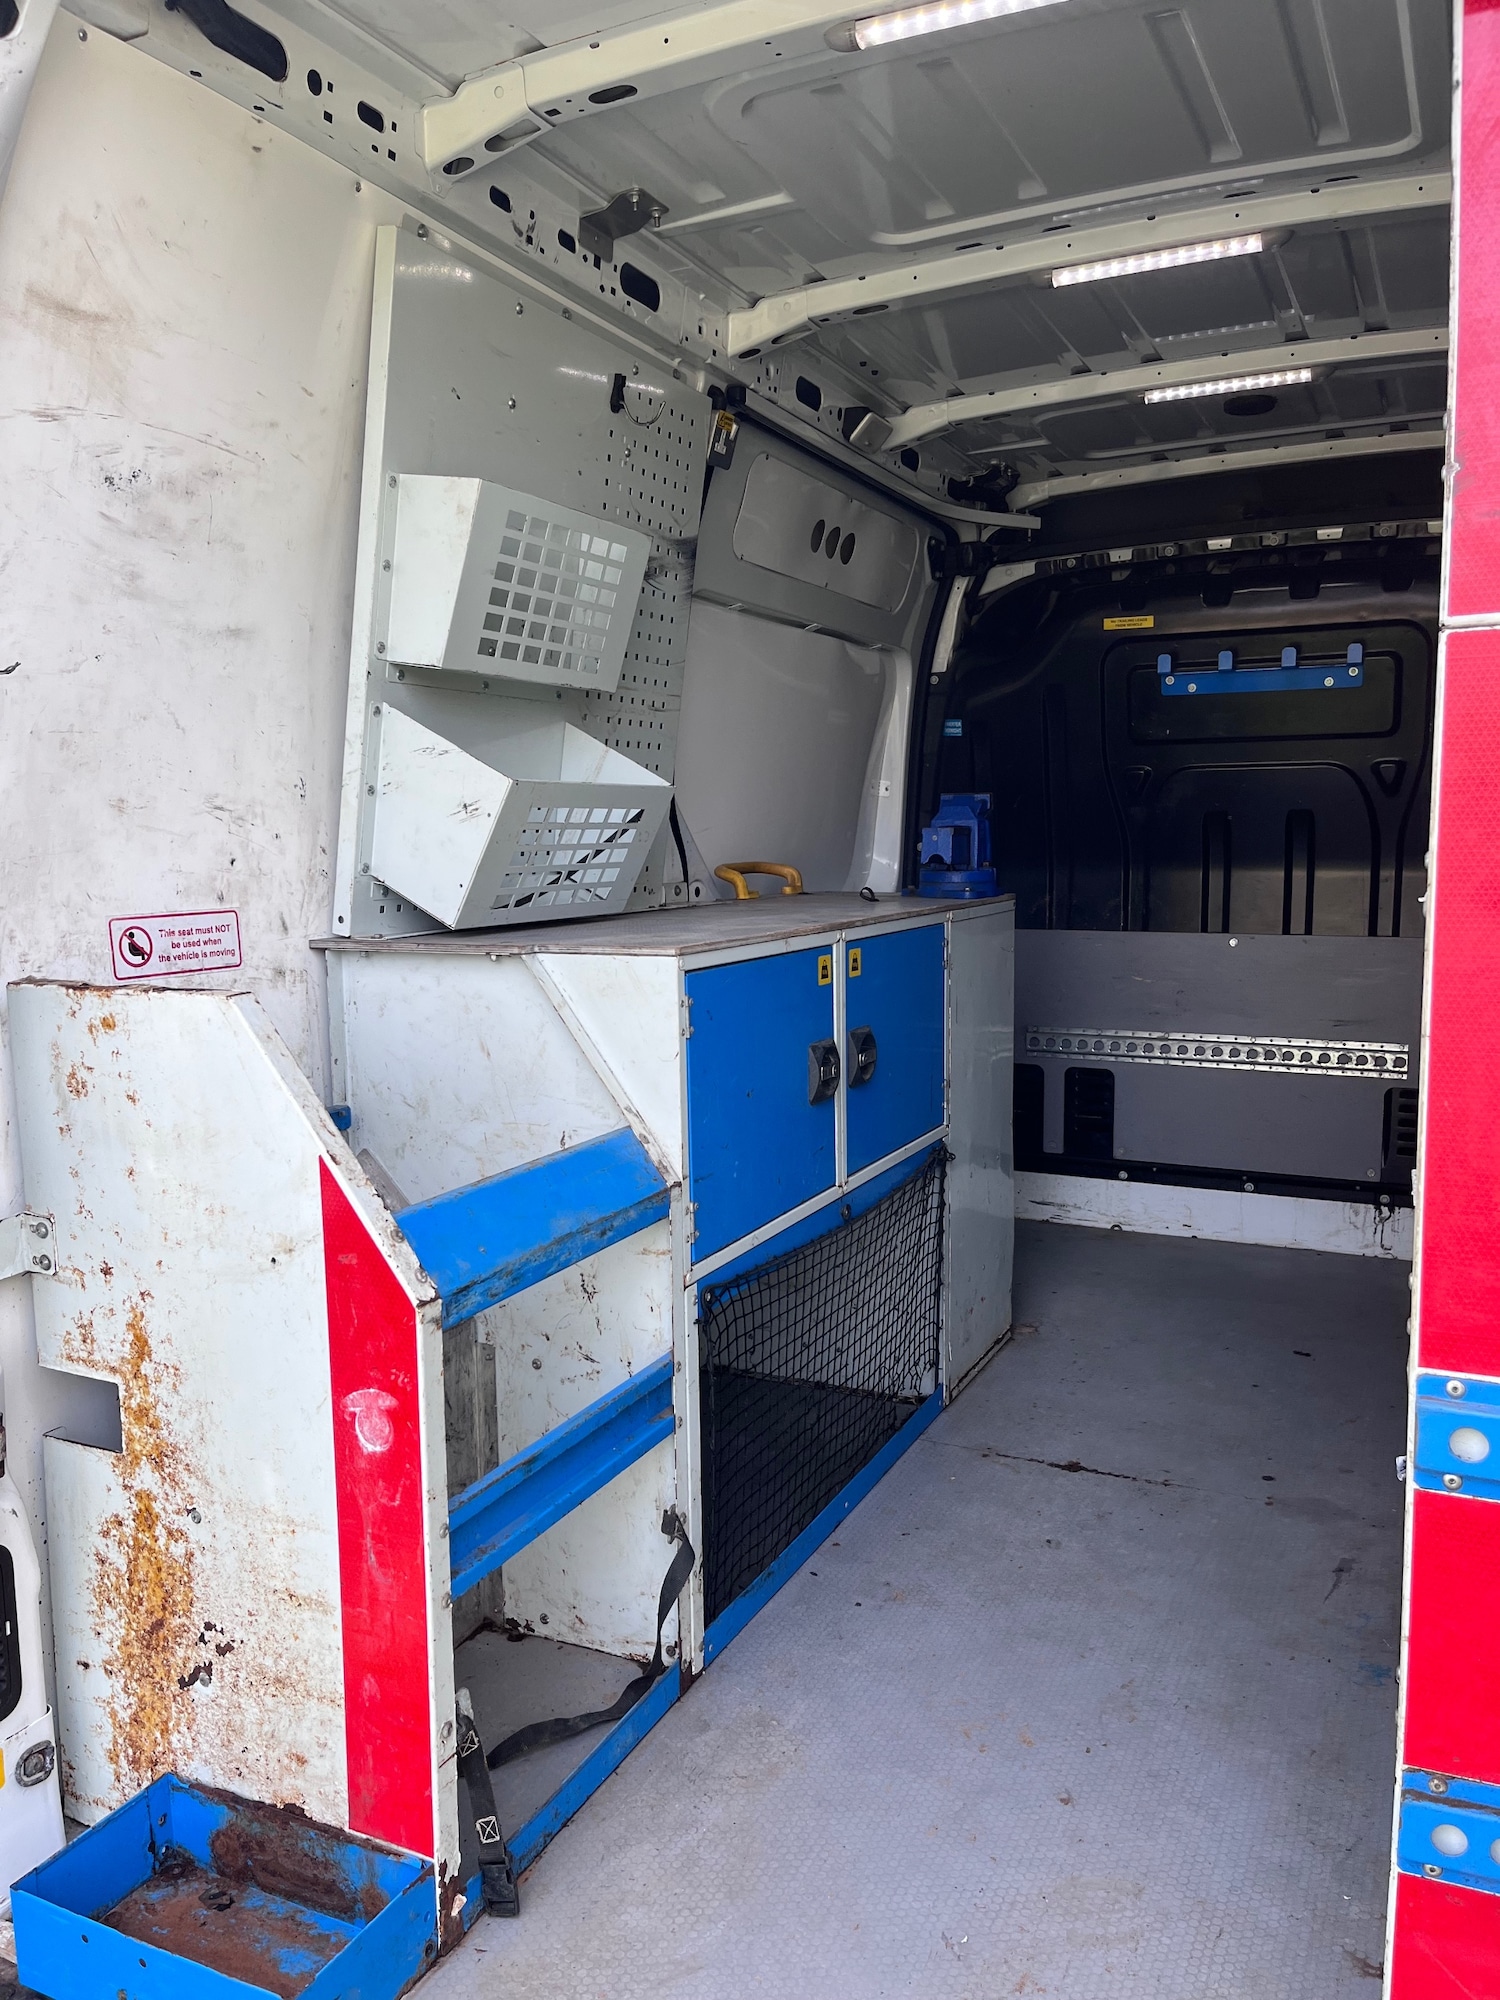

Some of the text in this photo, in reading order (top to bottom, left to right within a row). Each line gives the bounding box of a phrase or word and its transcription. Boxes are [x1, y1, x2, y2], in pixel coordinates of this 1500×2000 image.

[158, 924, 231, 938] This seat must NOT
[171, 937, 222, 949] be used when
[158, 948, 235, 963] the vehicle is moving
